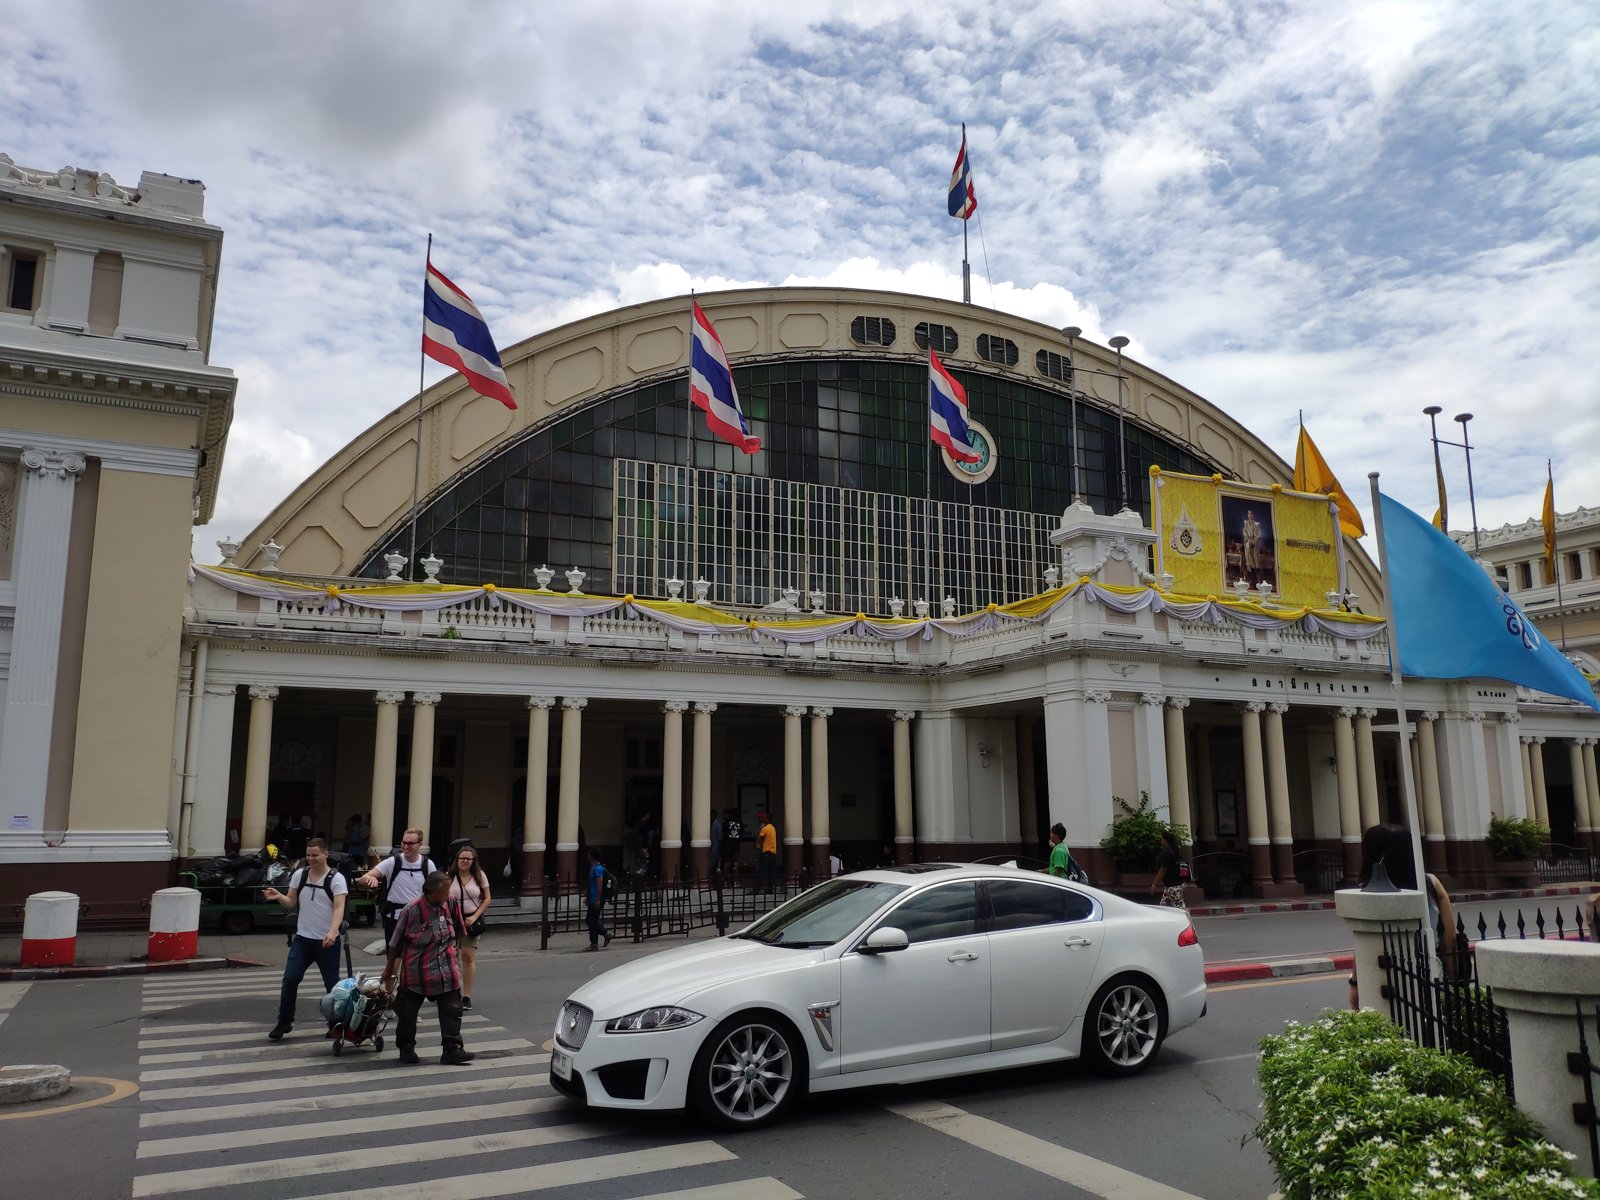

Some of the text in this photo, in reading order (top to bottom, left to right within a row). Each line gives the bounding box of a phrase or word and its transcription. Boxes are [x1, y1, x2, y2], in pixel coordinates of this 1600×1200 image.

[1252, 677, 1369, 694] สถานีกรุงเทพ
